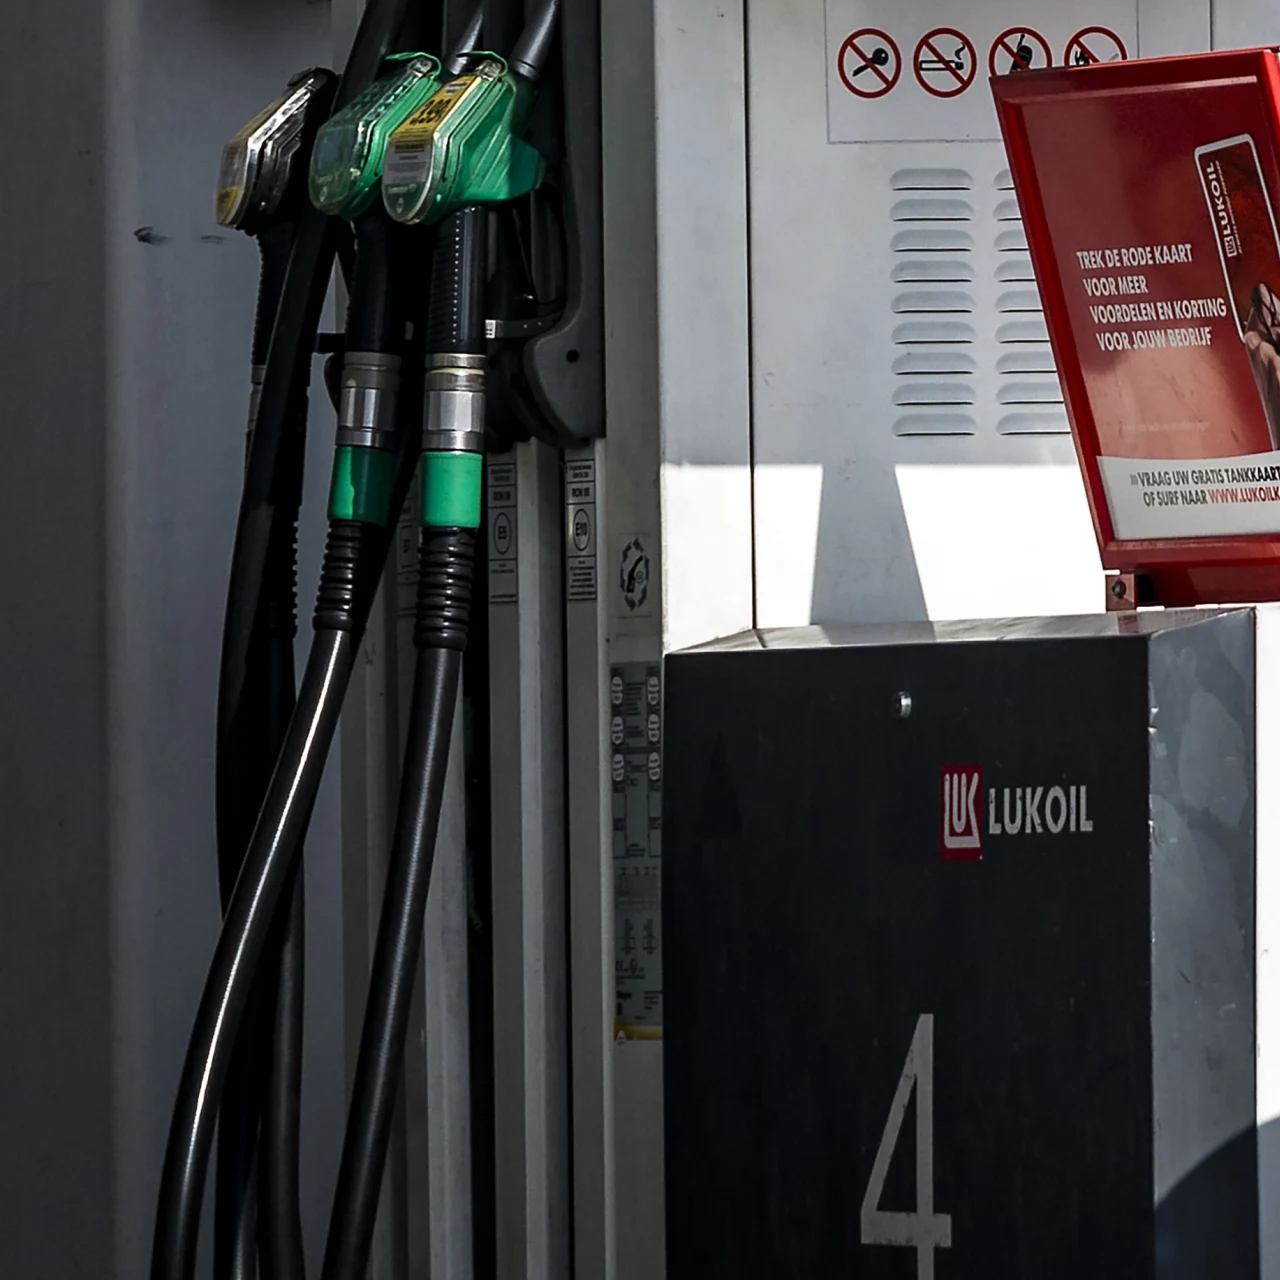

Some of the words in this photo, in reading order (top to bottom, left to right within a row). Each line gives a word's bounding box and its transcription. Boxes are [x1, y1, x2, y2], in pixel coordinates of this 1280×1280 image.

[1207, 162, 1231, 235] LUKOIL
[1076, 250, 1105, 269] TREK
[1105, 249, 1121, 267] DE
[1121, 247, 1153, 266] RODE
[1155, 244, 1192, 264] KAART
[1083, 276, 1118, 296] VOOR
[1118, 275, 1148, 294] MEER
[1089, 302, 1157, 324] VOORDELEN
[1157, 300, 1173, 320] EN
[1173, 297, 1227, 319] KORTING
[1096, 331, 1131, 351] VOOR
[1131, 329, 1166, 349] JOUW
[1137, 470, 1172, 487] VRAAG
[1173, 470, 1190, 485] UW
[1191, 468, 1224, 485] GRATIS
[1143, 491, 1157, 507] OF
[1157, 490, 1180, 506] SURF
[1181, 489, 1208, 505] NAAR
[988, 786, 1093, 835] LUKOIL
[861, 1014, 951, 1280] 4
